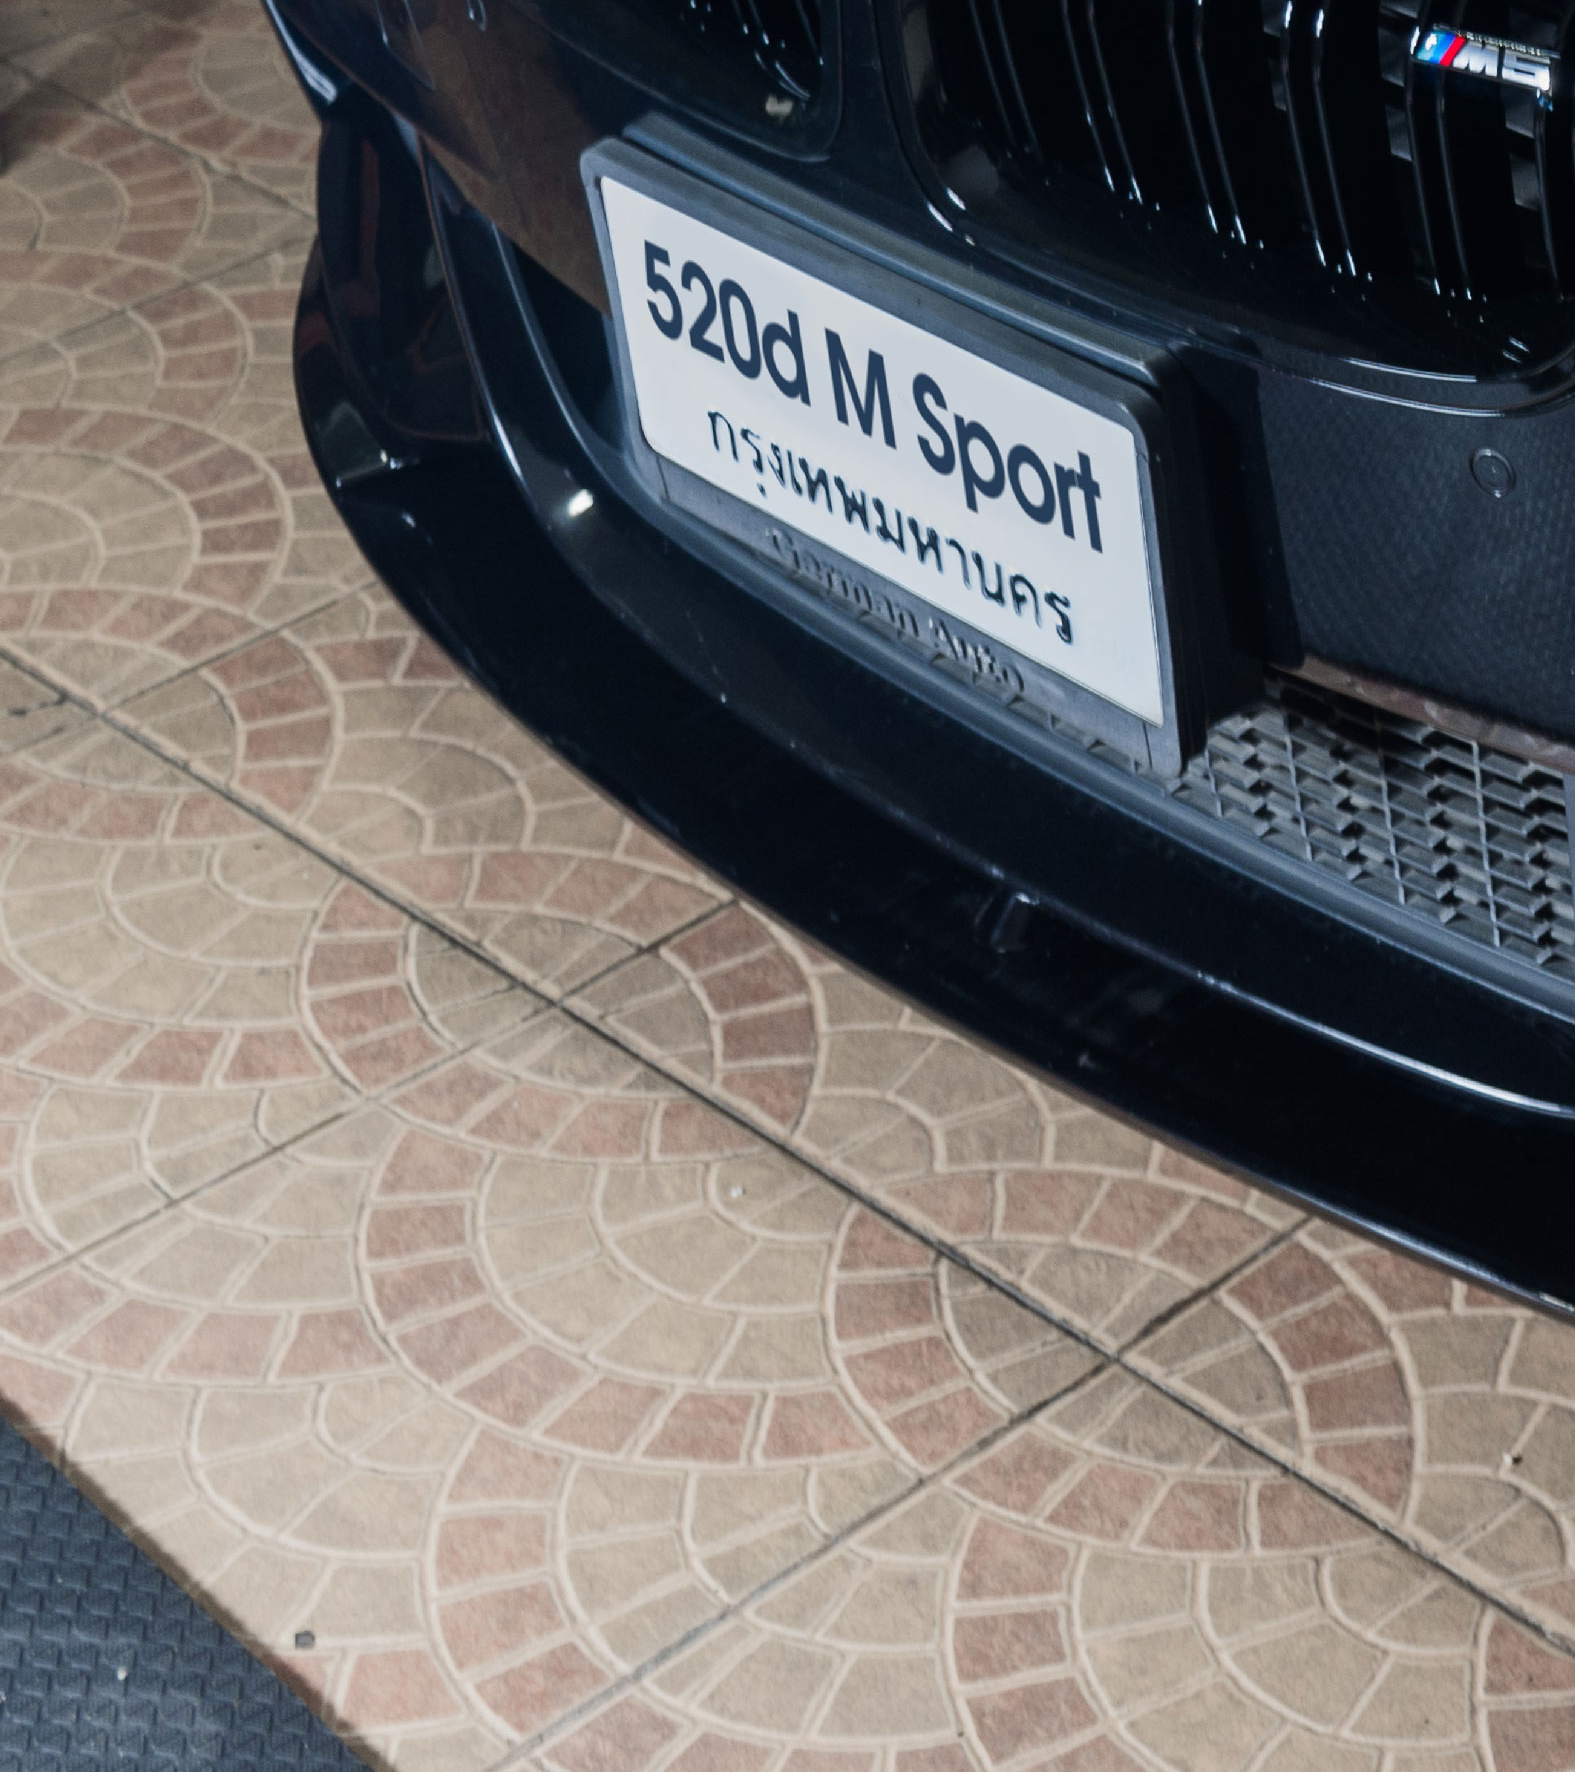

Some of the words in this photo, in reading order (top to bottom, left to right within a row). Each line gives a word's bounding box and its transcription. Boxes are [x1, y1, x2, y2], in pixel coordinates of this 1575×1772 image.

[644, 239, 811, 406] 520d
[825, 328, 897, 450] M
[912, 373, 1103, 554] Sport
[707, 411, 1073, 645] กรุงเทพมหานคร
